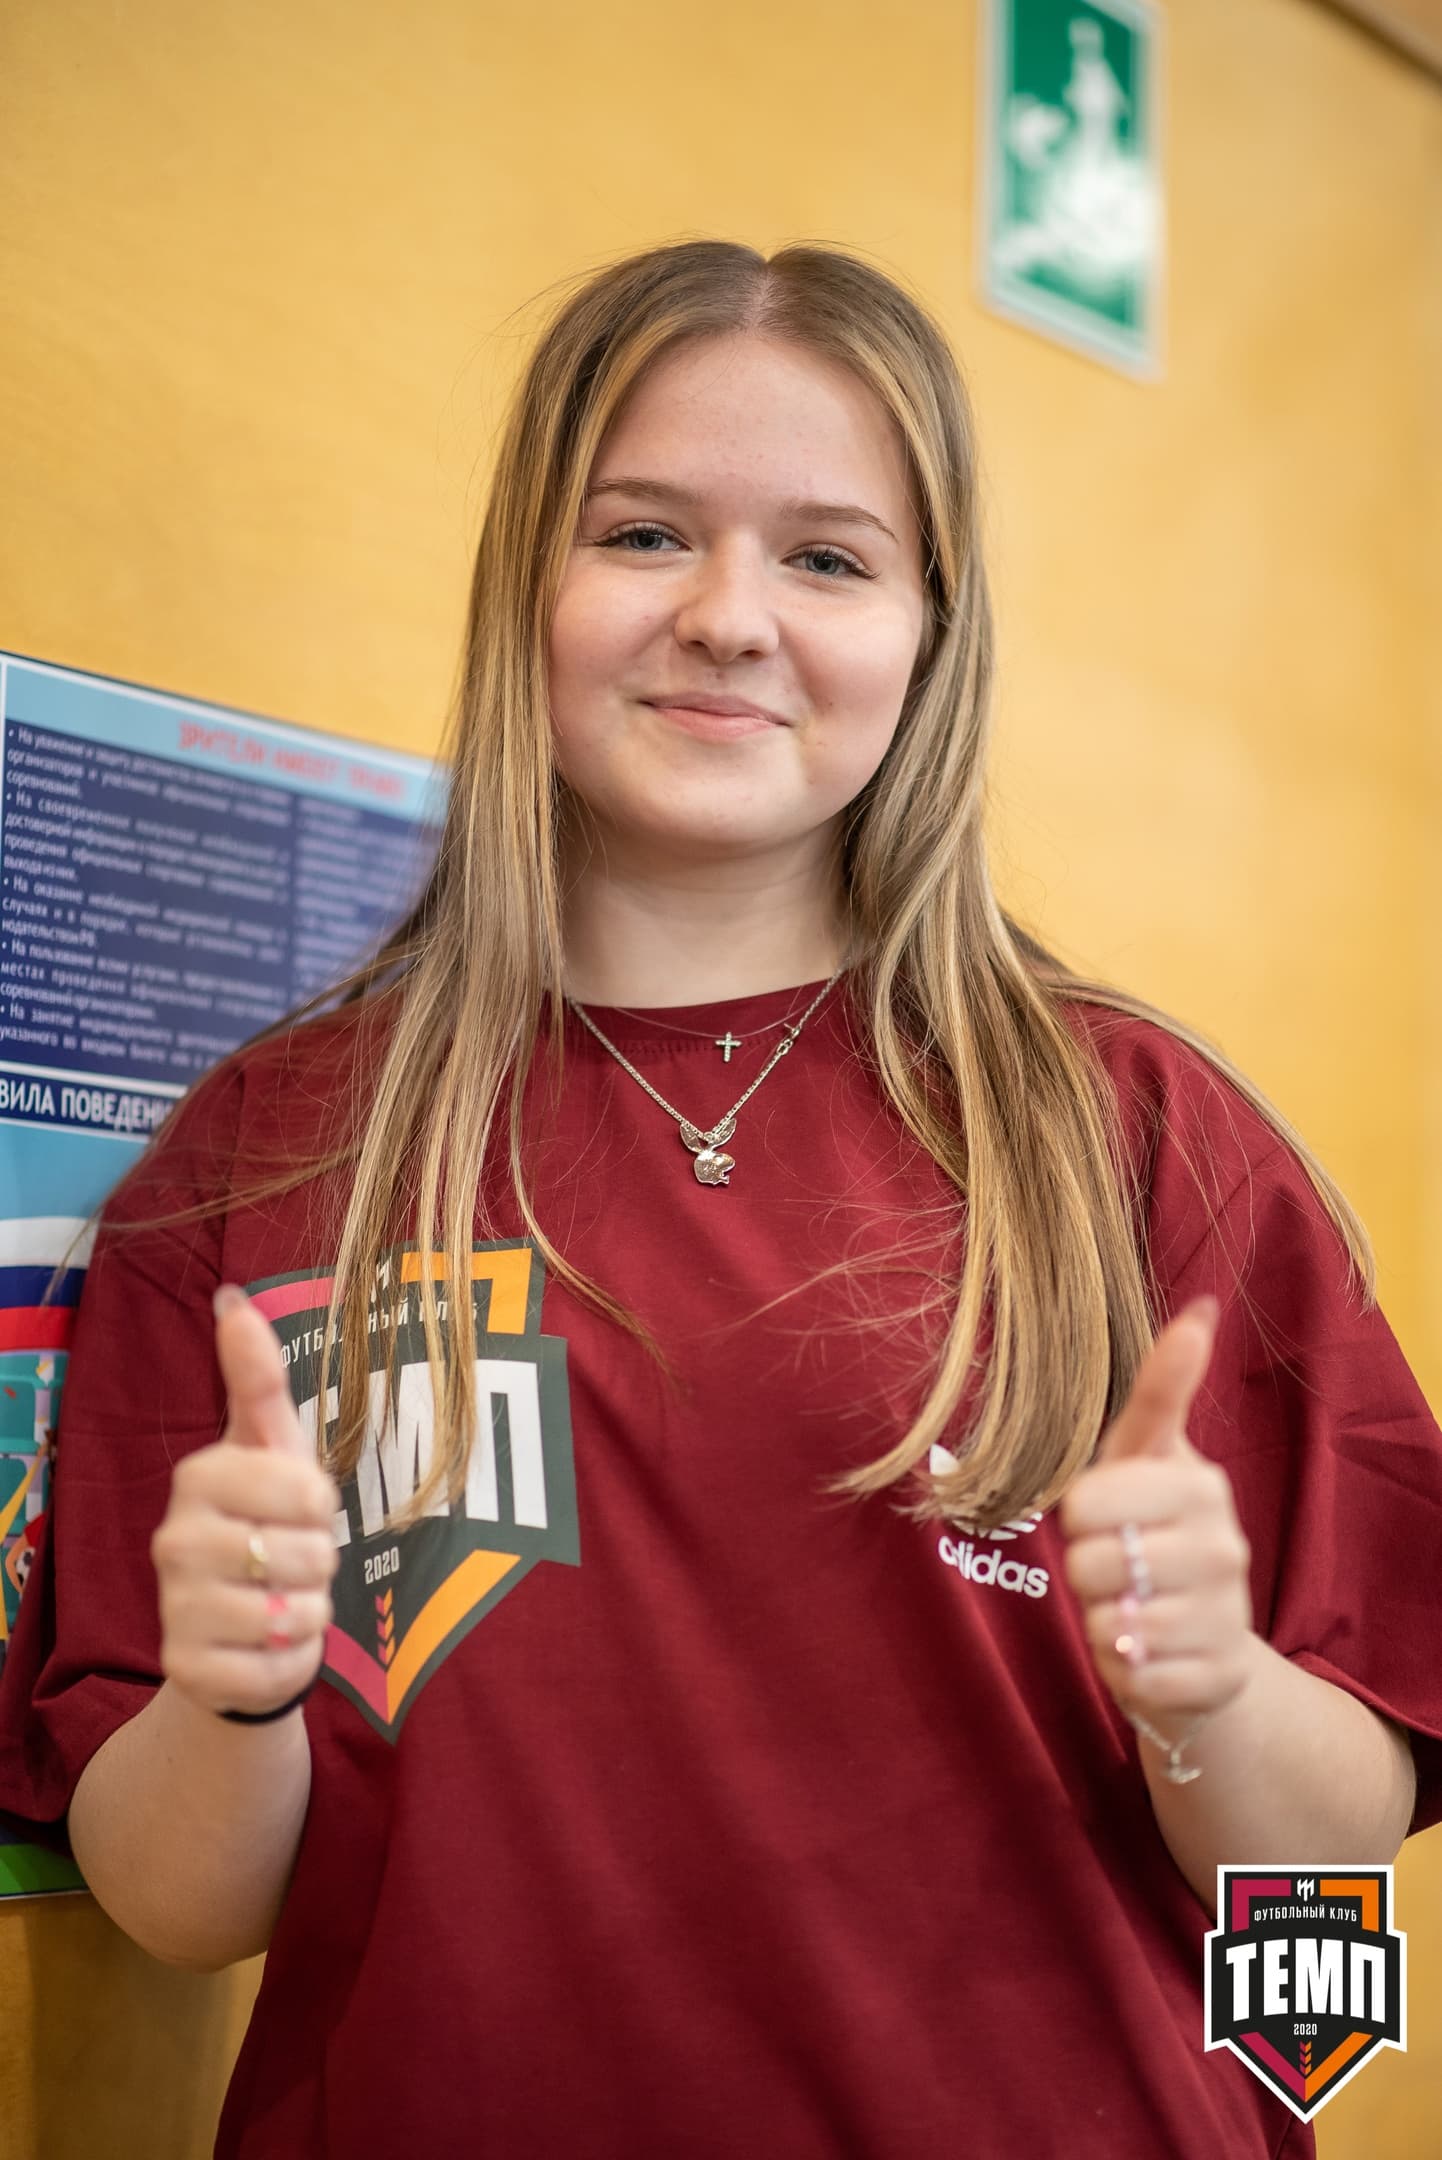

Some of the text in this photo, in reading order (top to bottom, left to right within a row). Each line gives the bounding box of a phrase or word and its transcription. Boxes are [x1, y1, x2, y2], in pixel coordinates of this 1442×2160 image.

[13, 874, 28, 894] На
[12, 938, 26, 957] На
[1, 961, 45, 981] местах
[10, 1001, 25, 1020] На
[280, 1297, 408, 1369] ФУТБНЫЙ
[299, 1359, 547, 1549] МП
[364, 1546, 400, 1585] 2020
